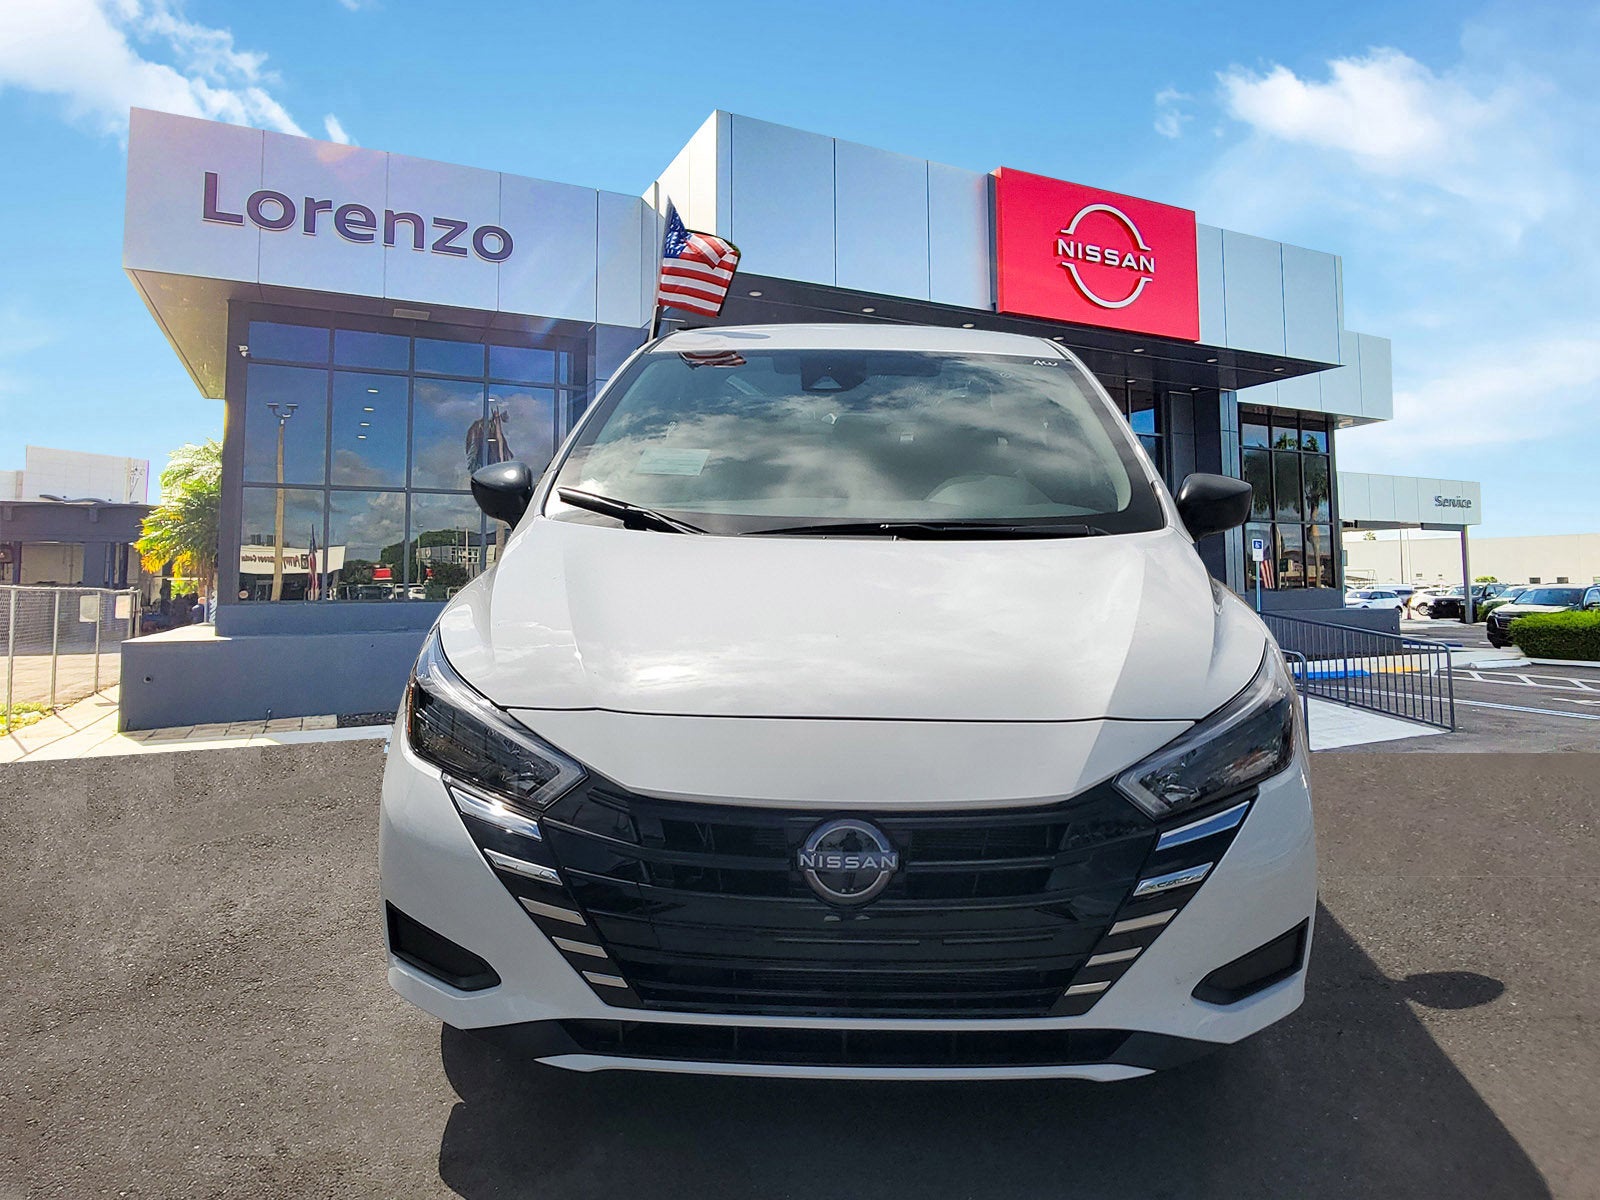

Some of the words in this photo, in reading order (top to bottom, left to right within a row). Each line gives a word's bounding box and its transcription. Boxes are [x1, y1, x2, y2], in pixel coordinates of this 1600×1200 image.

[202, 171, 515, 263] Lorenzo
[1057, 238, 1155, 273] NISSAN
[1434, 495, 1472, 508] Service
[800, 854, 896, 869] NISSAN
